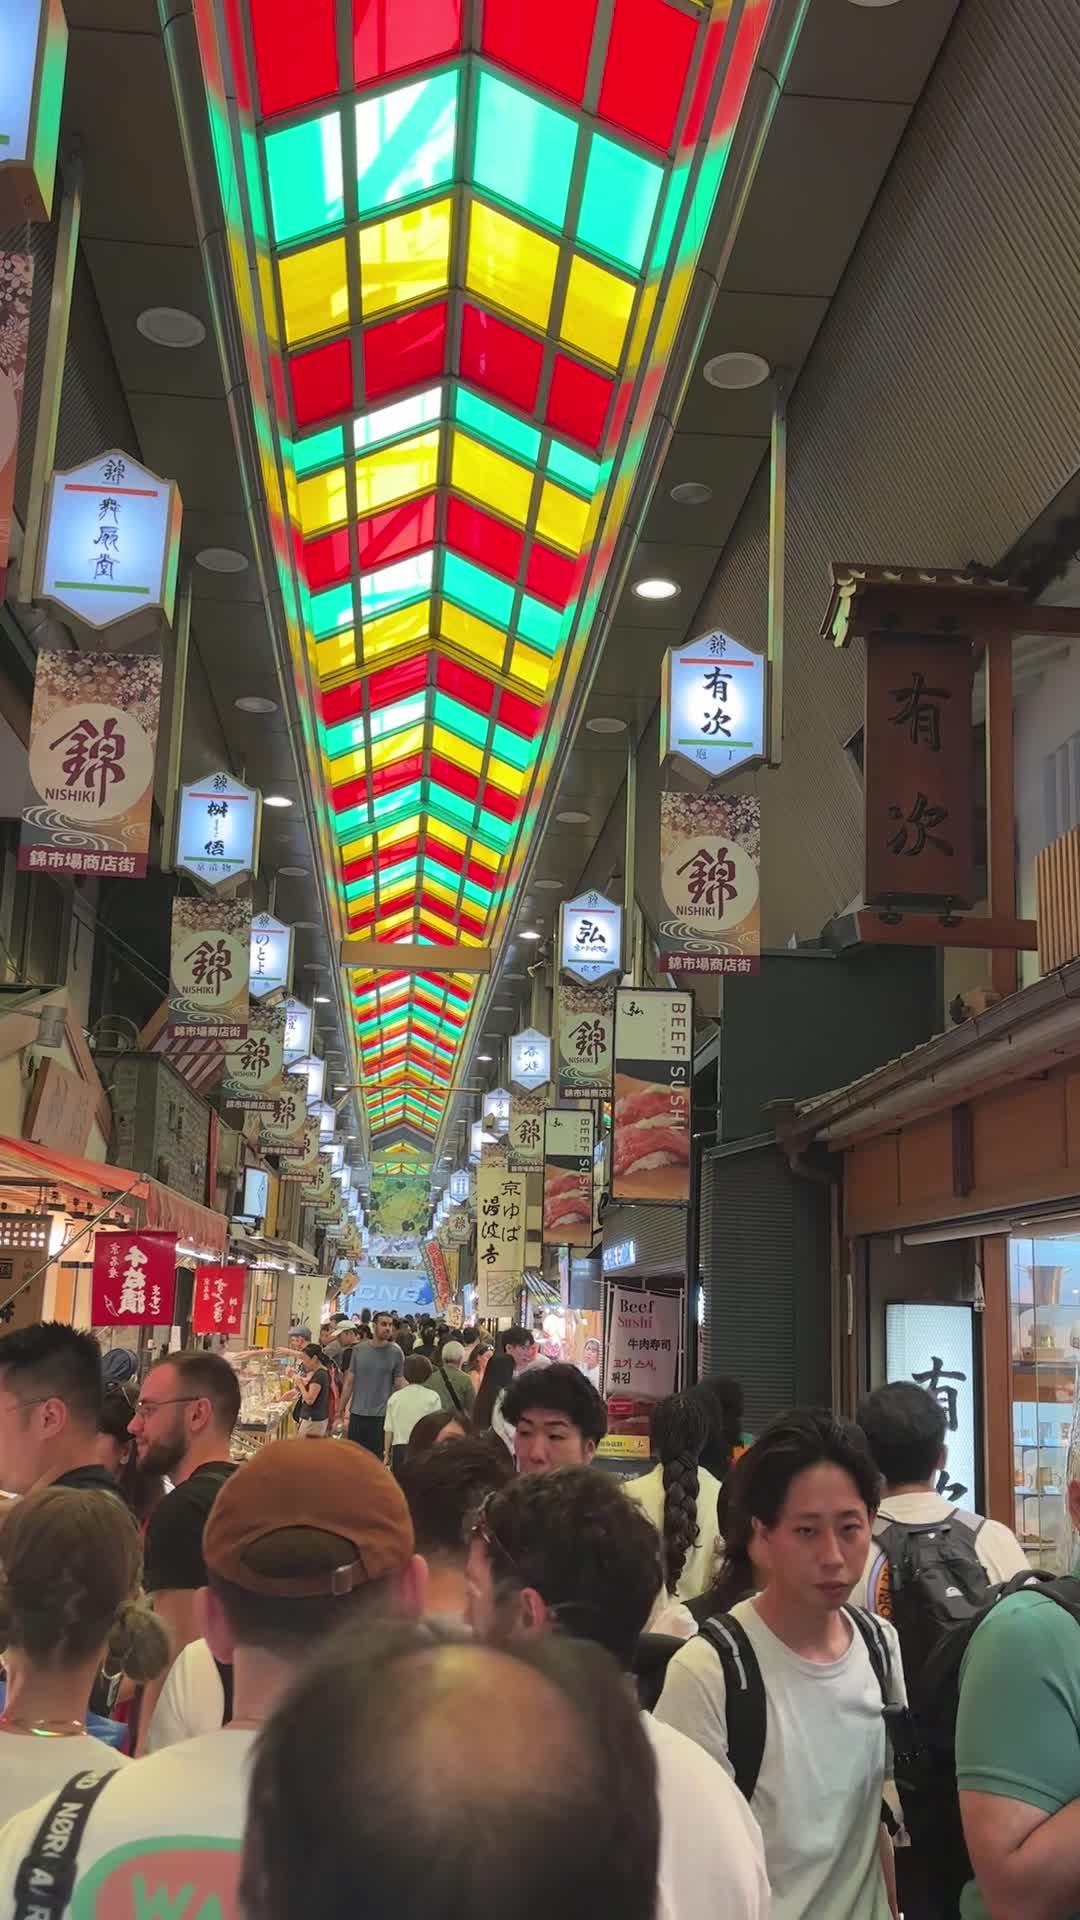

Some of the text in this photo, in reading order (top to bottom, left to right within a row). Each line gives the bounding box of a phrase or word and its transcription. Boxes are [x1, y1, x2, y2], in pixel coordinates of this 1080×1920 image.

[701, 666, 733, 737] 有次
[50, 718, 126, 808] 錦
[888, 672, 953, 856] 有次
[45, 788, 95, 803] NISHIKI
[29, 850, 135, 873] 錦市場商店街
[676, 847, 738, 920] 錦
[676, 905, 716, 917] NISHIKI
[576, 919, 606, 944] 弘
[183, 939, 232, 996] 錦
[668, 956, 751, 973] 錦市場商店街
[182, 985, 214, 995] NISHIKI
[174, 1025, 240, 1037] 錦市場商店街
[568, 1019, 607, 1065] 錦
[670, 1002, 686, 1130] BEEF SUSHI
[515, 1119, 541, 1149] 錦
[580, 1118, 590, 1200] BEEF SUSHI
[501, 1181, 521, 1242] 京ゆば
[620, 1299, 654, 1314] Beef
[613, 1358, 632, 1369] 고기
